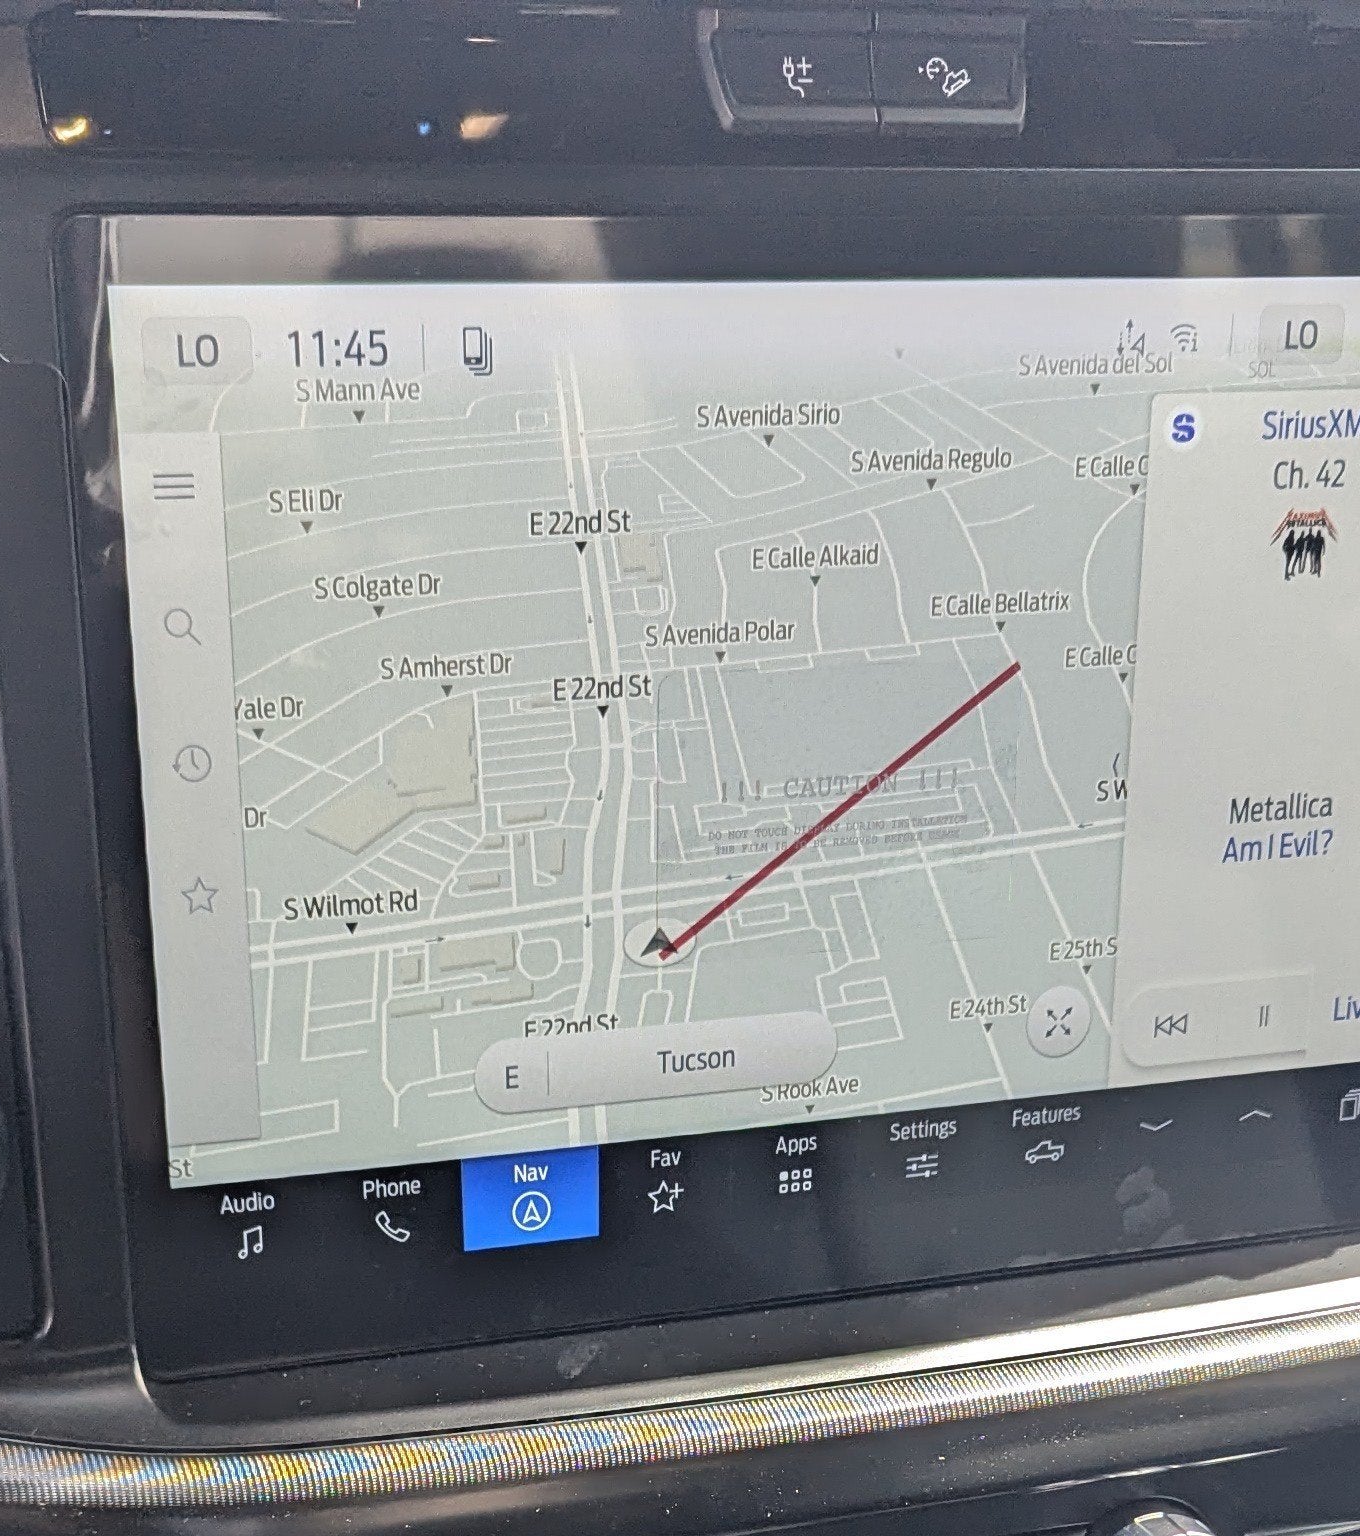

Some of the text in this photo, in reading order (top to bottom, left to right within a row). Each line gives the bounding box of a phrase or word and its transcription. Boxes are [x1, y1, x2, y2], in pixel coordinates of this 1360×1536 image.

[1284, 319, 1318, 350] LO
[176, 333, 220, 368] LO
[288, 329, 389, 368] 11:45
[1018, 351, 1173, 377] S Avenida del Sol
[296, 377, 421, 402] S Mann Ave
[697, 402, 841, 428] S Avenida Sirio
[851, 447, 1012, 473] S Avenida Regulo
[1075, 457, 1087, 478] E
[1090, 455, 1135, 477] Calle
[1273, 458, 1346, 490] Ch. 42
[269, 488, 343, 512] S Eli Dr
[529, 509, 631, 535] E 22nd St
[752, 543, 880, 570] E Calle Alkaid
[314, 573, 441, 605] S Colgate Dr
[931, 590, 1070, 617] E Calle Bellatrix
[645, 618, 796, 648] S Avenida Polar
[380, 652, 512, 681] S Amherst Dr
[1065, 647, 1077, 668] E
[1080, 645, 1123, 667] Calle
[553, 675, 652, 701] E 22nd St
[281, 696, 304, 718] Dr
[783, 773, 899, 799] CAUTION
[1096, 780, 1109, 802] S
[244, 806, 267, 828] Dr
[1229, 792, 1333, 825] Metallica
[708, 831, 722, 841] DO
[727, 829, 748, 840] NOT
[755, 827, 788, 839] TOUCH
[1222, 829, 1334, 864] Am I Evil?
[283, 889, 418, 921] S Wilmot Rd
[1050, 942, 1060, 961] E
[1063, 938, 1103, 961] 25th
[950, 994, 1027, 1020] E 24th St
[657, 1048, 736, 1074] Tucson
[504, 1066, 519, 1090] E
[826, 1075, 860, 1096] Ave
[1012, 1104, 1082, 1128] Features
[889, 1118, 958, 1142] Settings
[650, 1148, 682, 1169] Fav
[775, 1135, 818, 1157] Apps
[513, 1163, 549, 1184] Nav
[362, 1176, 422, 1199] Phone
[220, 1191, 275, 1215] Audio
